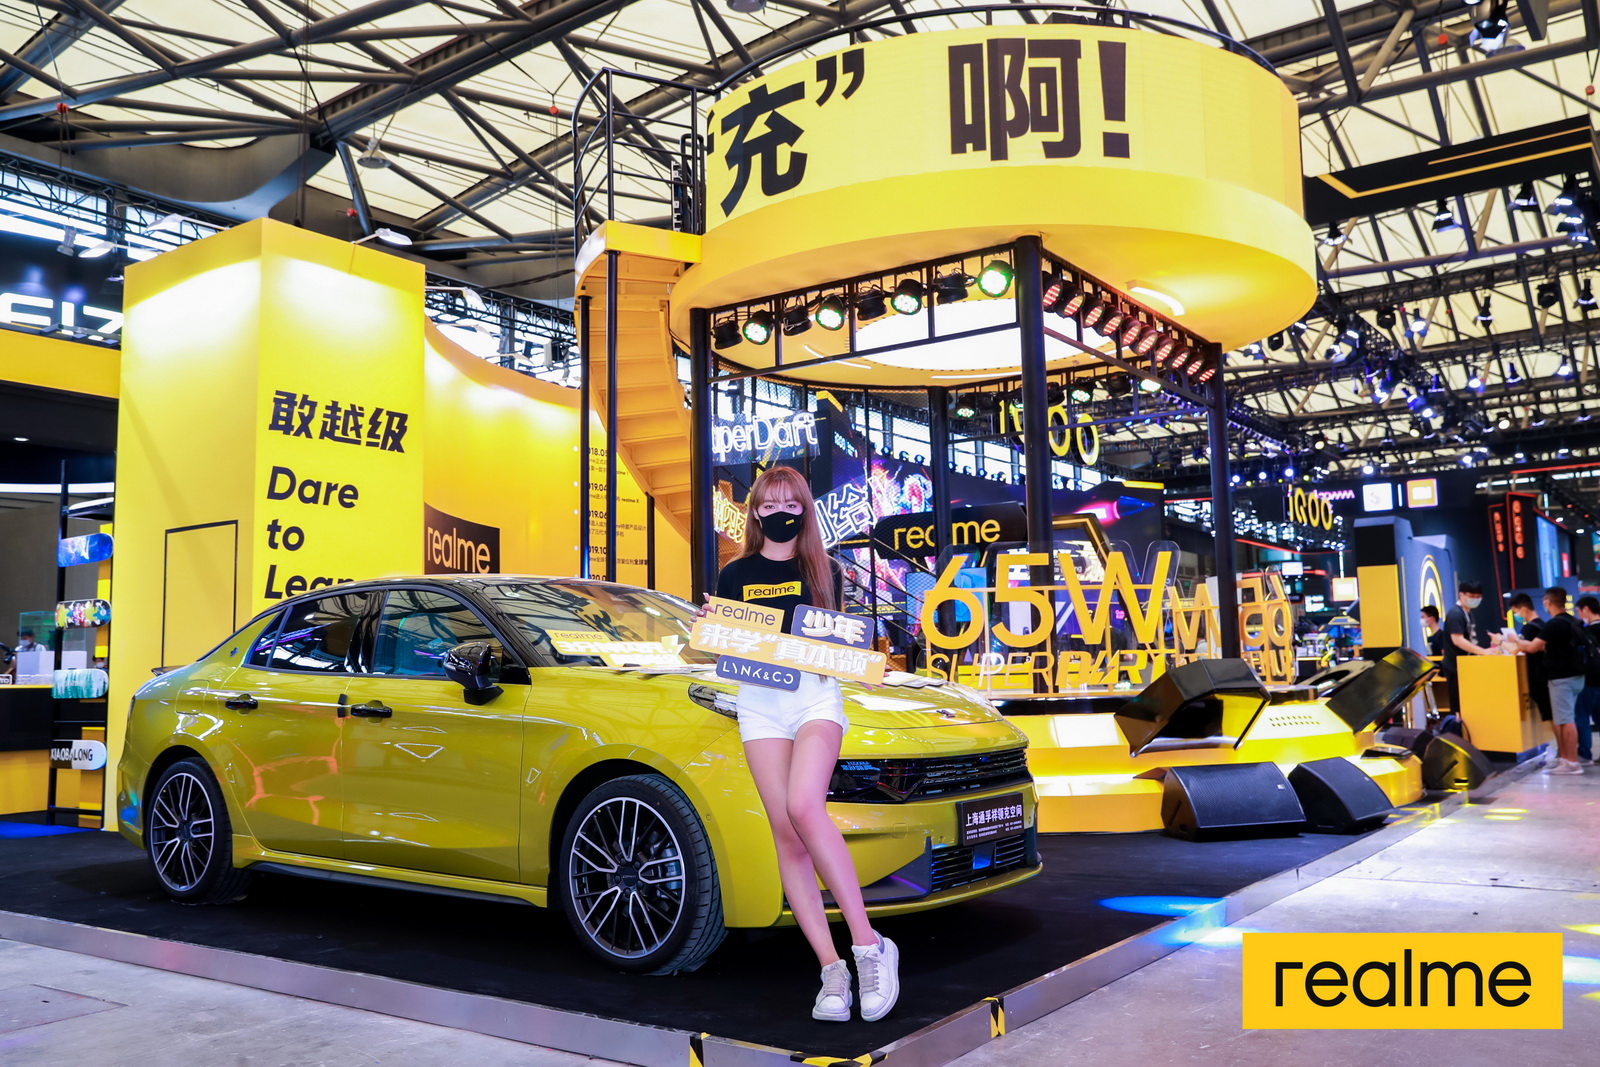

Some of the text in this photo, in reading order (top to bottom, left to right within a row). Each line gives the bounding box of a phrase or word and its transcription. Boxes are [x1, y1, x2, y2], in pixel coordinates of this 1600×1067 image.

[268, 390, 408, 453] 敢越级
[711, 412, 818, 462] uperDart
[266, 465, 359, 508] Dare
[266, 519, 305, 551] to
[427, 526, 491, 574] realme
[588, 545, 607, 555] 19.10
[893, 519, 1001, 550] reame
[264, 564, 356, 600] Lea
[748, 585, 796, 597] realme
[715, 604, 776, 626] realme
[921, 551, 1173, 650] 65W
[553, 632, 603, 641] realme
[801, 610, 868, 645] 少年
